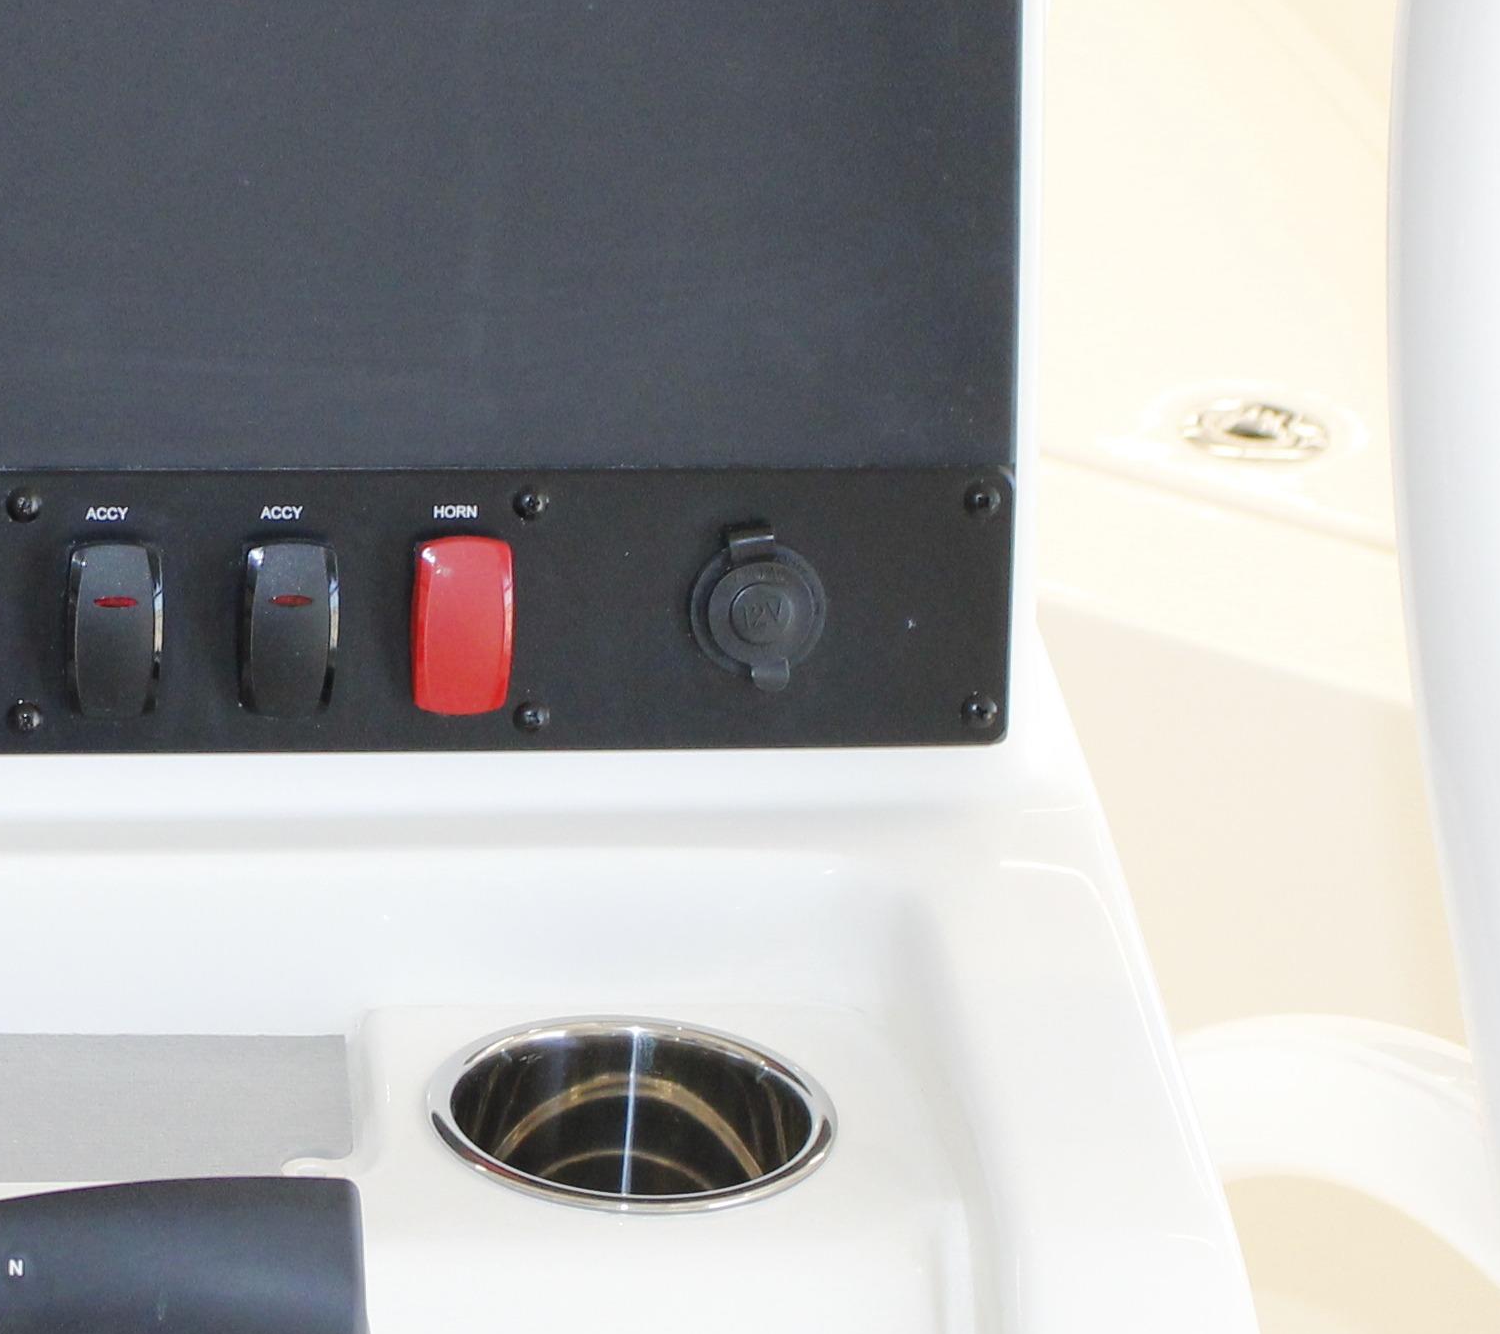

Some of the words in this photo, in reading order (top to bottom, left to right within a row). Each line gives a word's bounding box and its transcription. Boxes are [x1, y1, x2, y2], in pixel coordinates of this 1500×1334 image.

[85, 506, 129, 521] ACCY
[259, 505, 304, 520] ACCY
[432, 504, 478, 519] HORN
[742, 597, 785, 629] 12V
[8, 1258, 24, 1277] N
